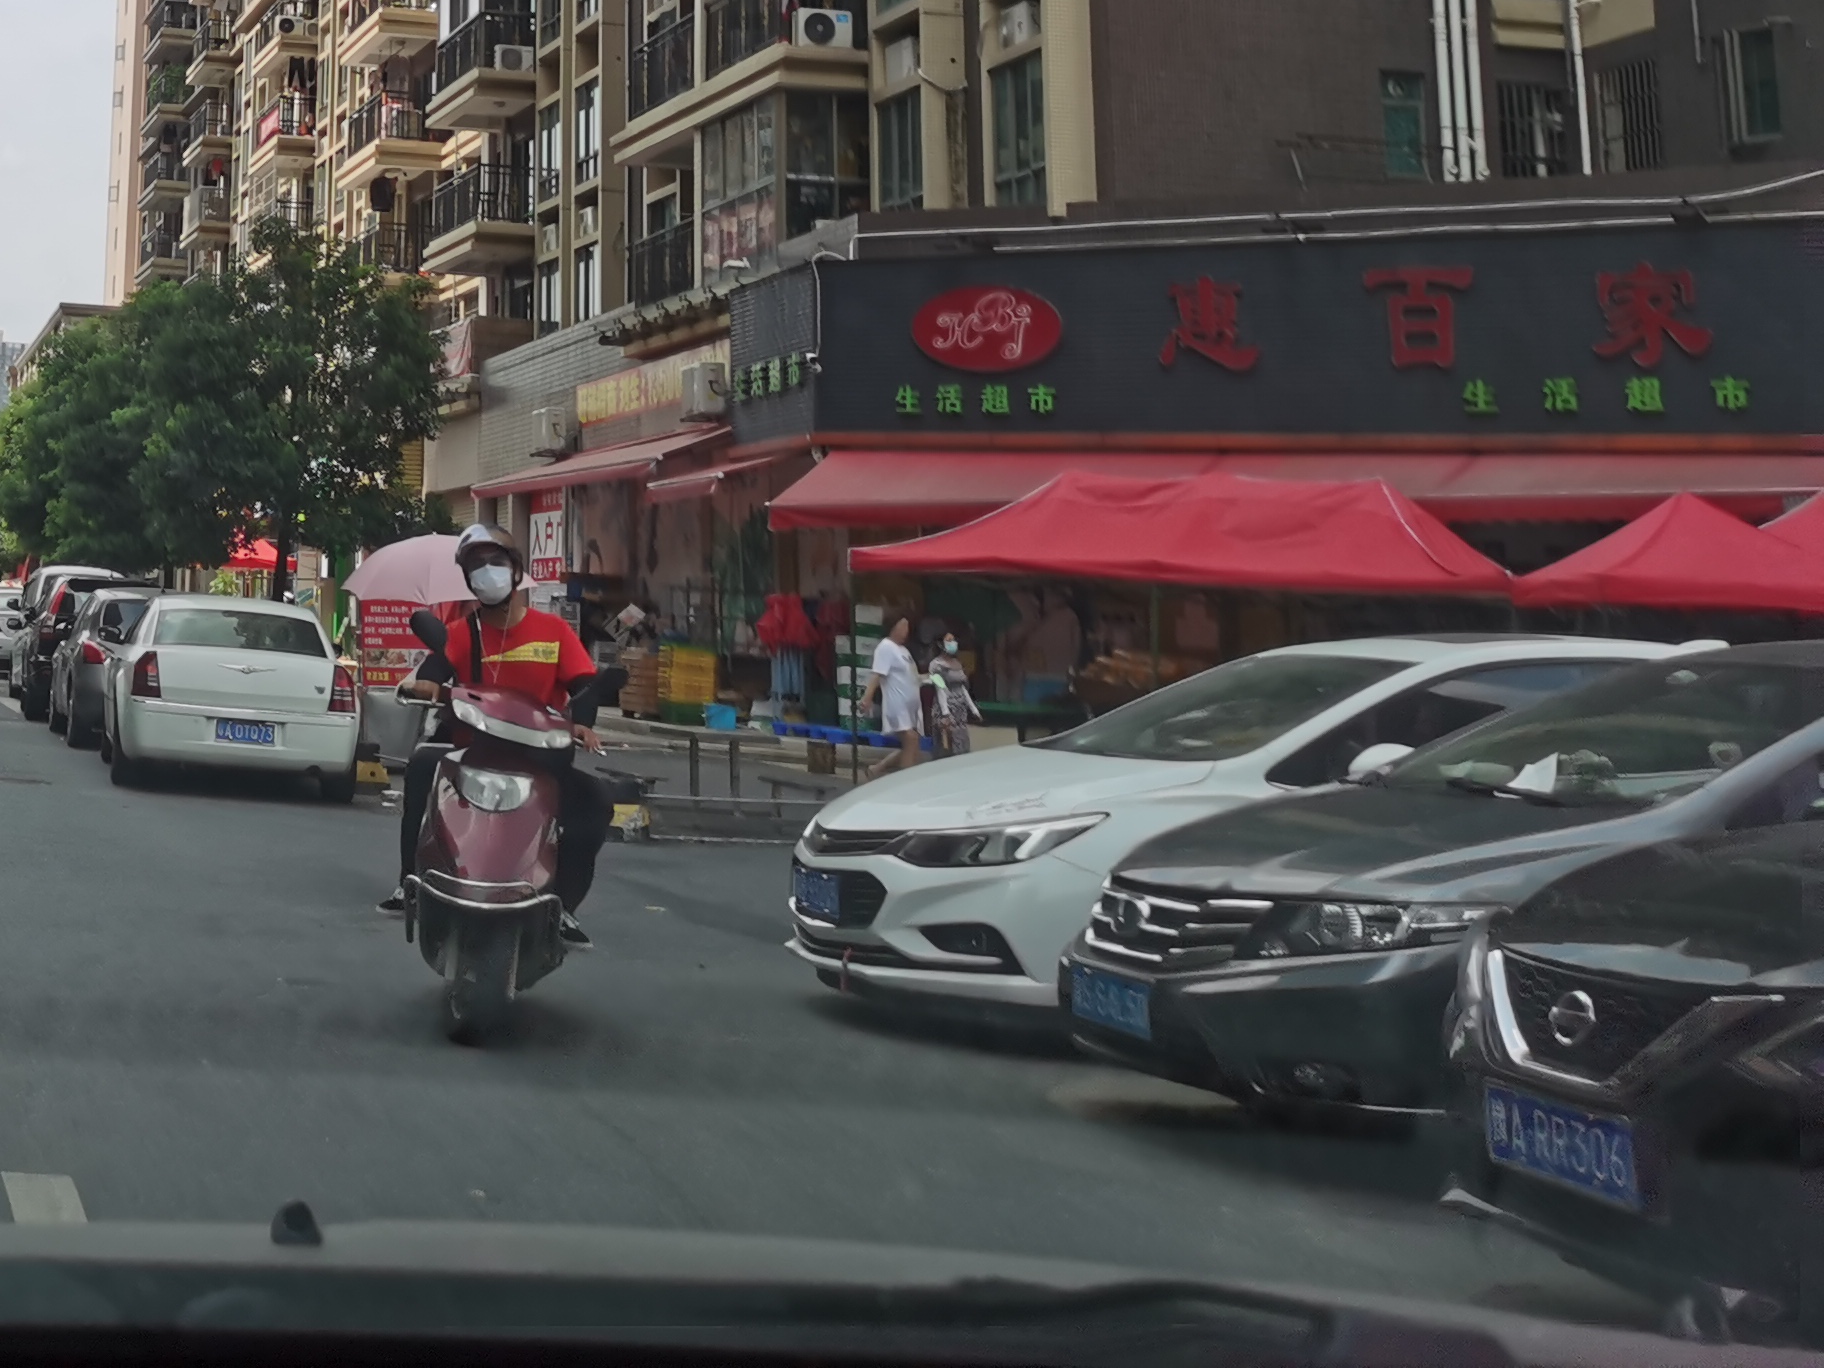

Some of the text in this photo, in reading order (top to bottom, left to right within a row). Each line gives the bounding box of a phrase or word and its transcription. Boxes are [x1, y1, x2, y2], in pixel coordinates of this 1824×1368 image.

[1159, 261, 1713, 370] 惠百家
[895, 383, 1056, 415] 生活超市
[1461, 375, 1750, 413] 生活超市
